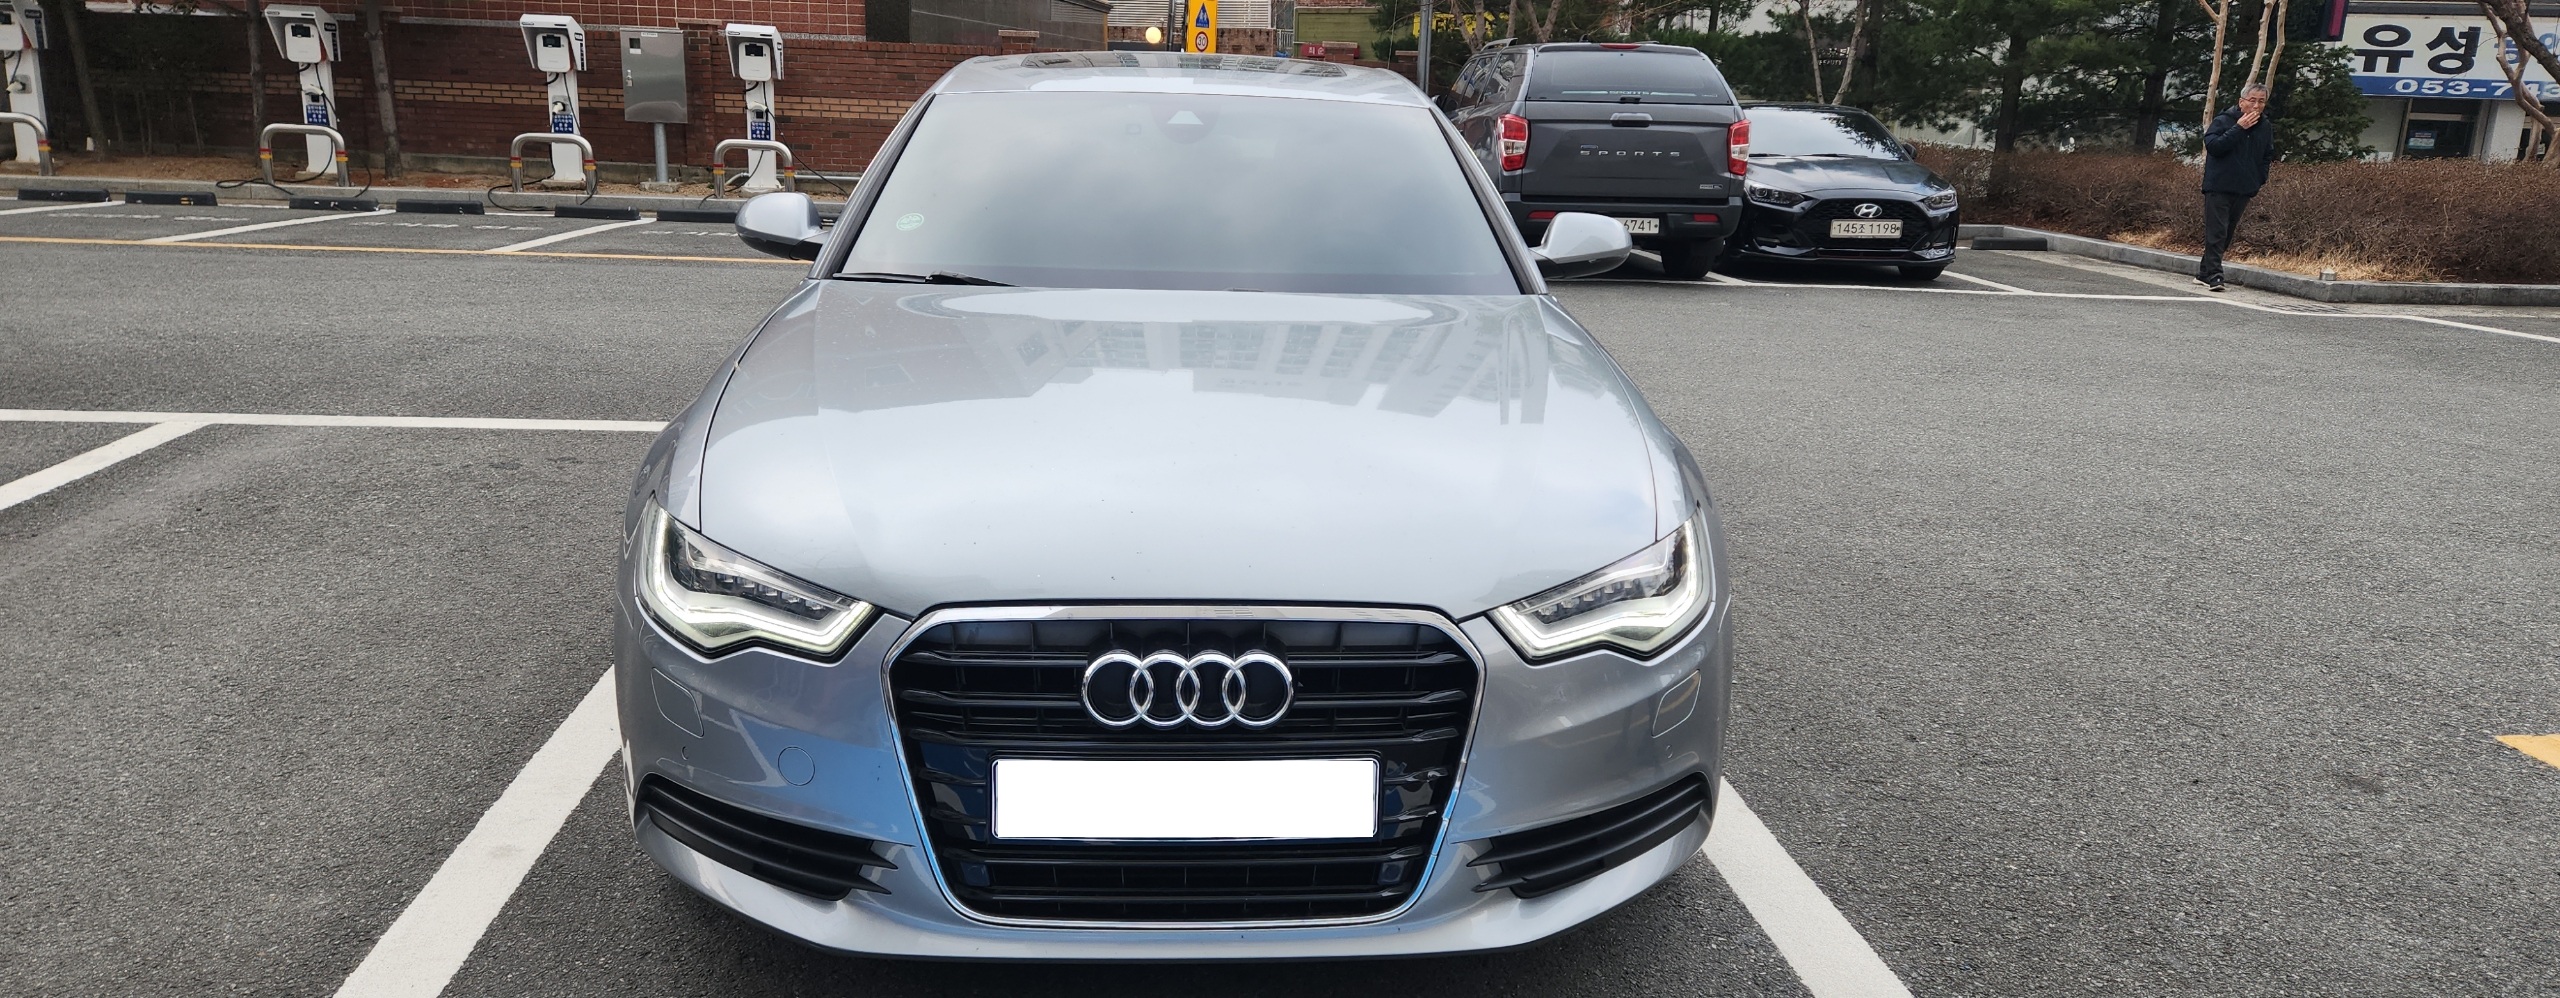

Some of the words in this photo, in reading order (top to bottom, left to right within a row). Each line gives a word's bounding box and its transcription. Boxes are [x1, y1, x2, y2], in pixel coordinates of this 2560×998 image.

[1198, 36, 1206, 46] 30
[2354, 24, 2482, 75] 유성
[1837, 222, 1866, 234] 145조
[1869, 223, 1897, 234] 1198
